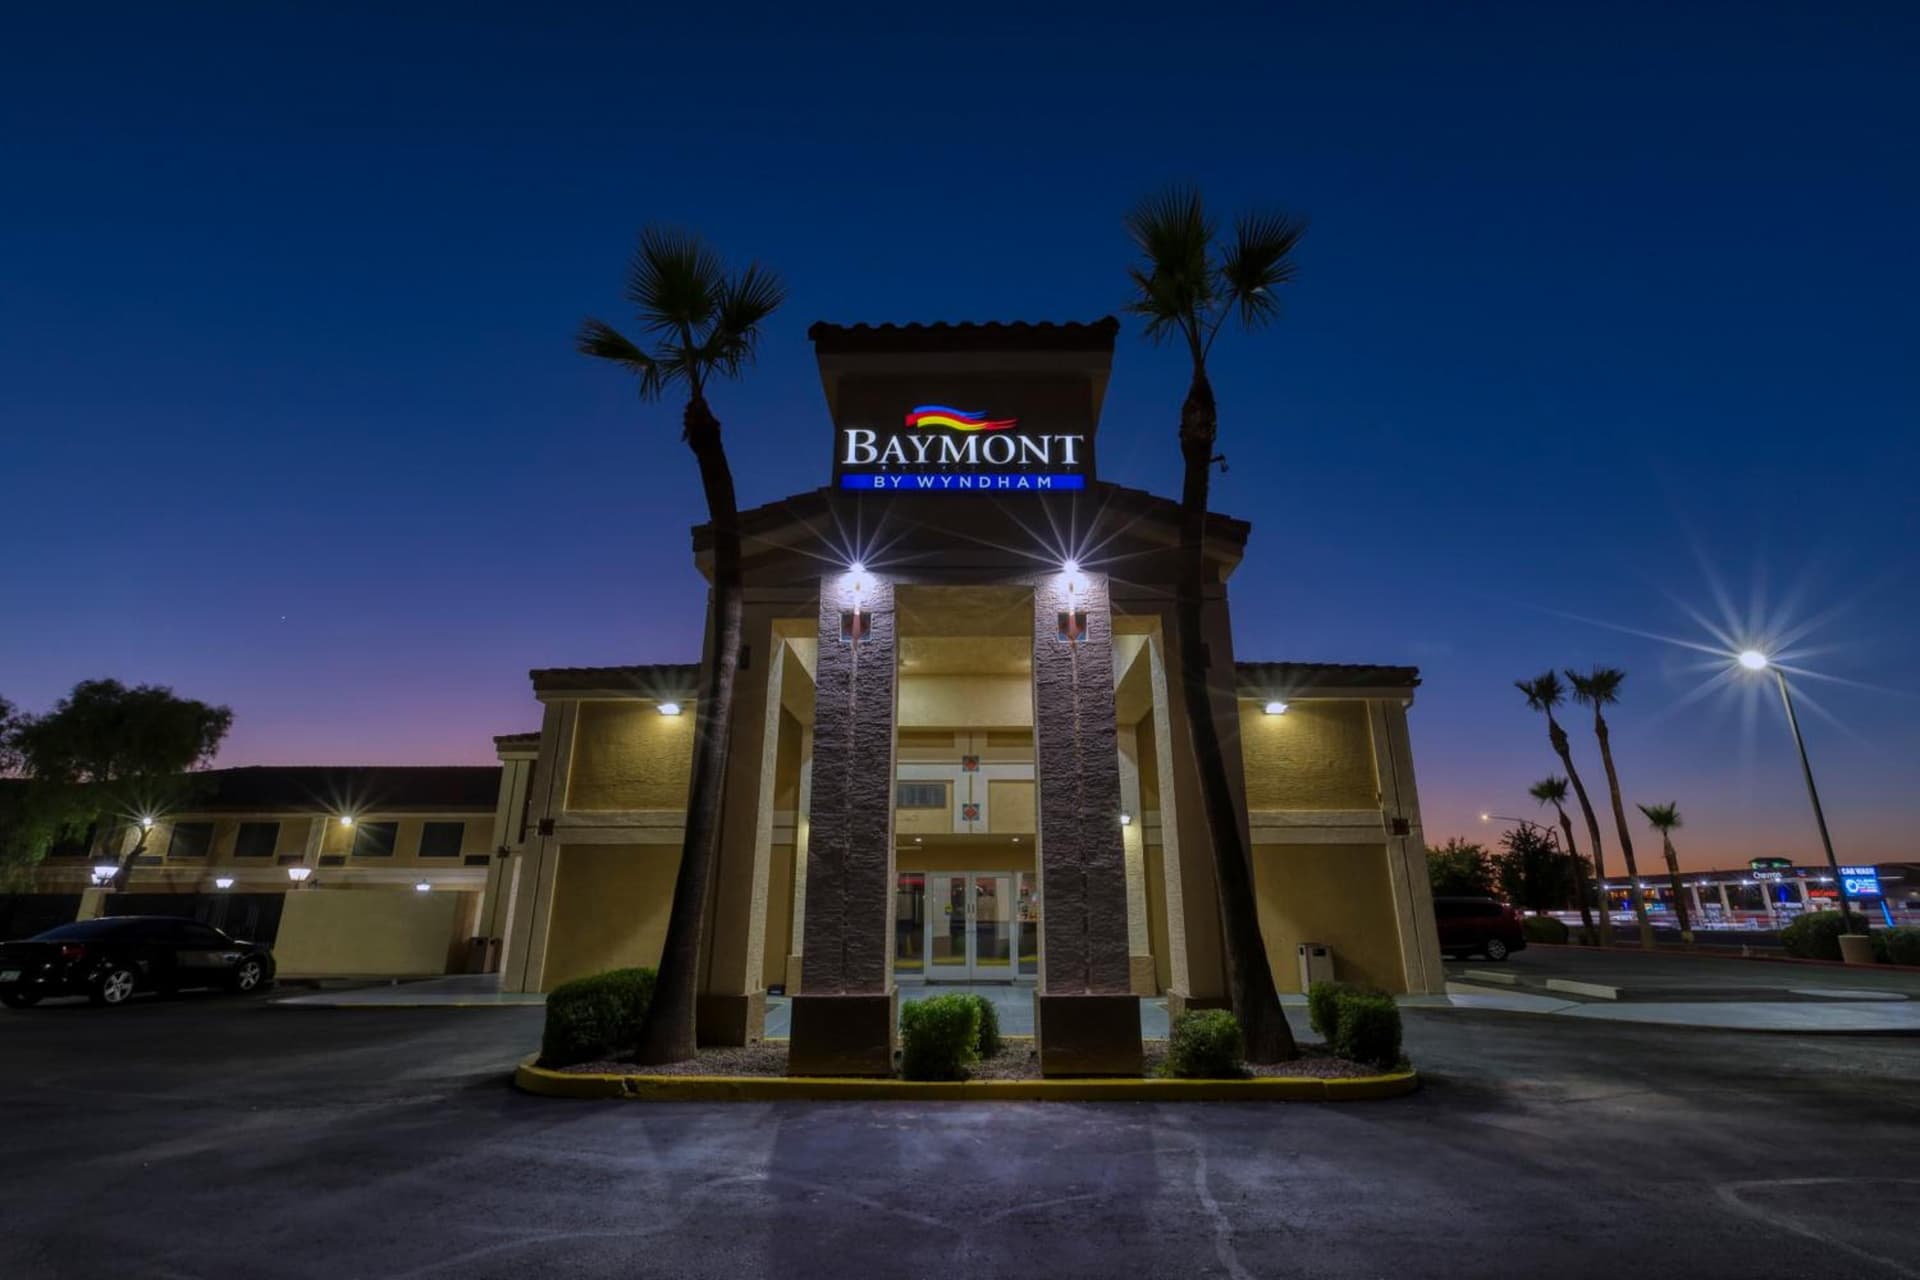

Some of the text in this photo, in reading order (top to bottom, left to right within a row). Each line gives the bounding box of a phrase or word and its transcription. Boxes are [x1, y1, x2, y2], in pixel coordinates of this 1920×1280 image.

[841, 429, 1084, 465] BAYMONT
[873, 475, 1052, 489] BY WYNDHAM
